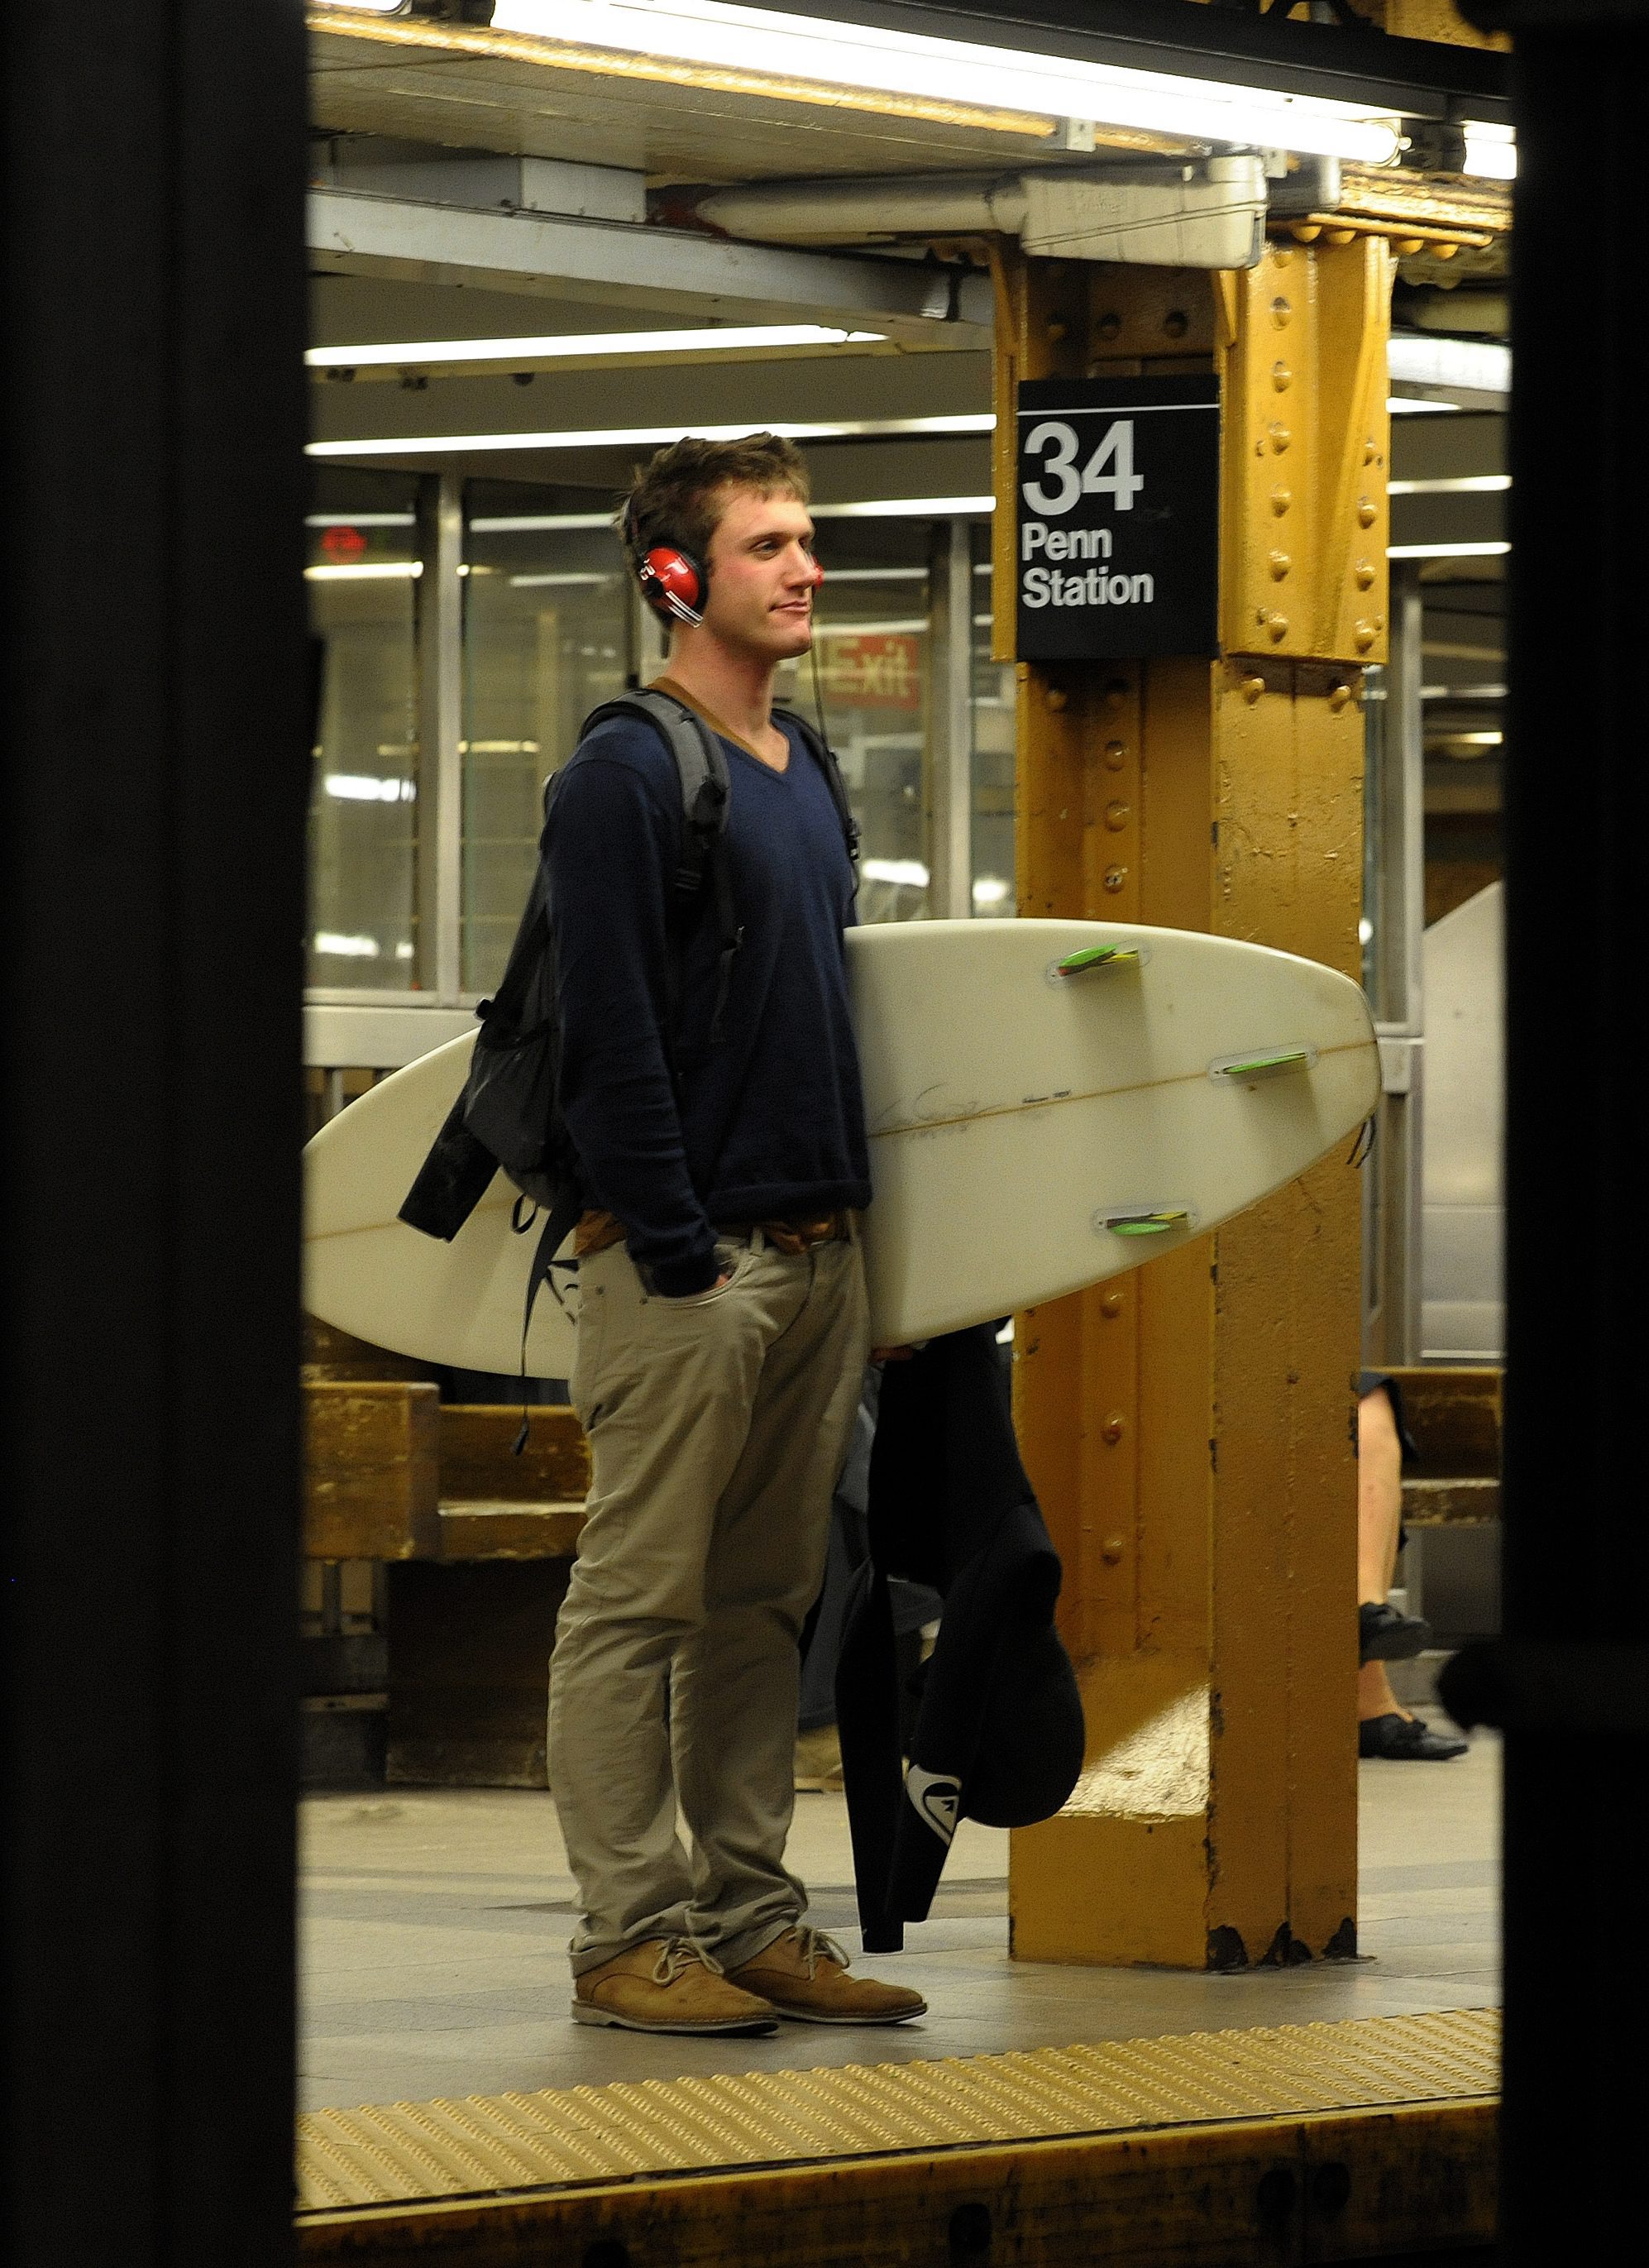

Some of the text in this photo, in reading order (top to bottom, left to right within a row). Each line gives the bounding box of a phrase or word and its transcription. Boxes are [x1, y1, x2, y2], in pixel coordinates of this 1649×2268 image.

[1022, 420, 1145, 515] 34
[1022, 522, 1112, 561] Penn
[1022, 566, 1154, 609] Station
[826, 638, 908, 696] Exit
